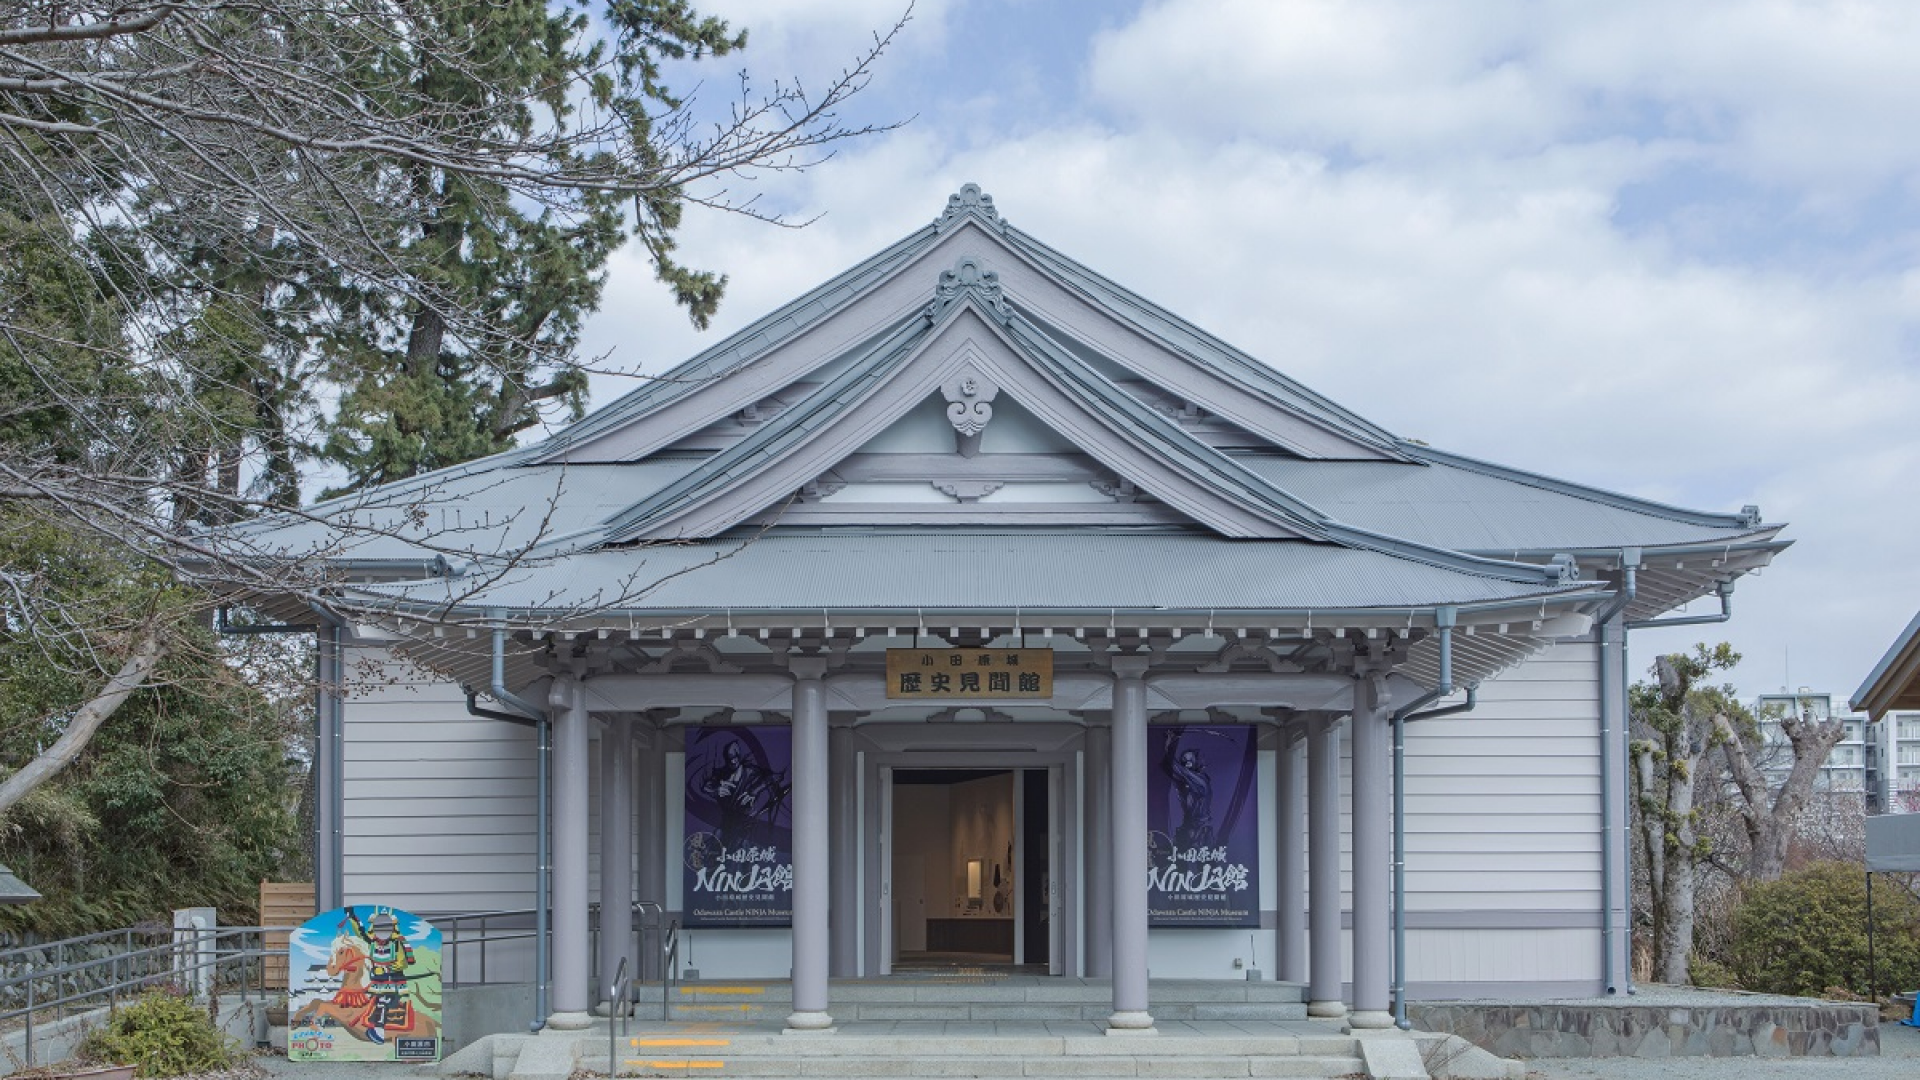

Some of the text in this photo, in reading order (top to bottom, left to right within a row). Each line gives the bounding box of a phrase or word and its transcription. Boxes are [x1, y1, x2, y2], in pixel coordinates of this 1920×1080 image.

[921, 653, 1019, 666] 小田原城
[900, 671, 1041, 693] 歴史見聞館
[716, 846, 777, 863] 小田原城
[1167, 846, 1228, 863] 小田原城
[724, 908, 745, 916] Castle
[745, 908, 767, 917] NINJA
[1177, 908, 1198, 916] Castle
[1198, 908, 1220, 917] NINJA
[291, 1037, 333, 1052] PHOTO
